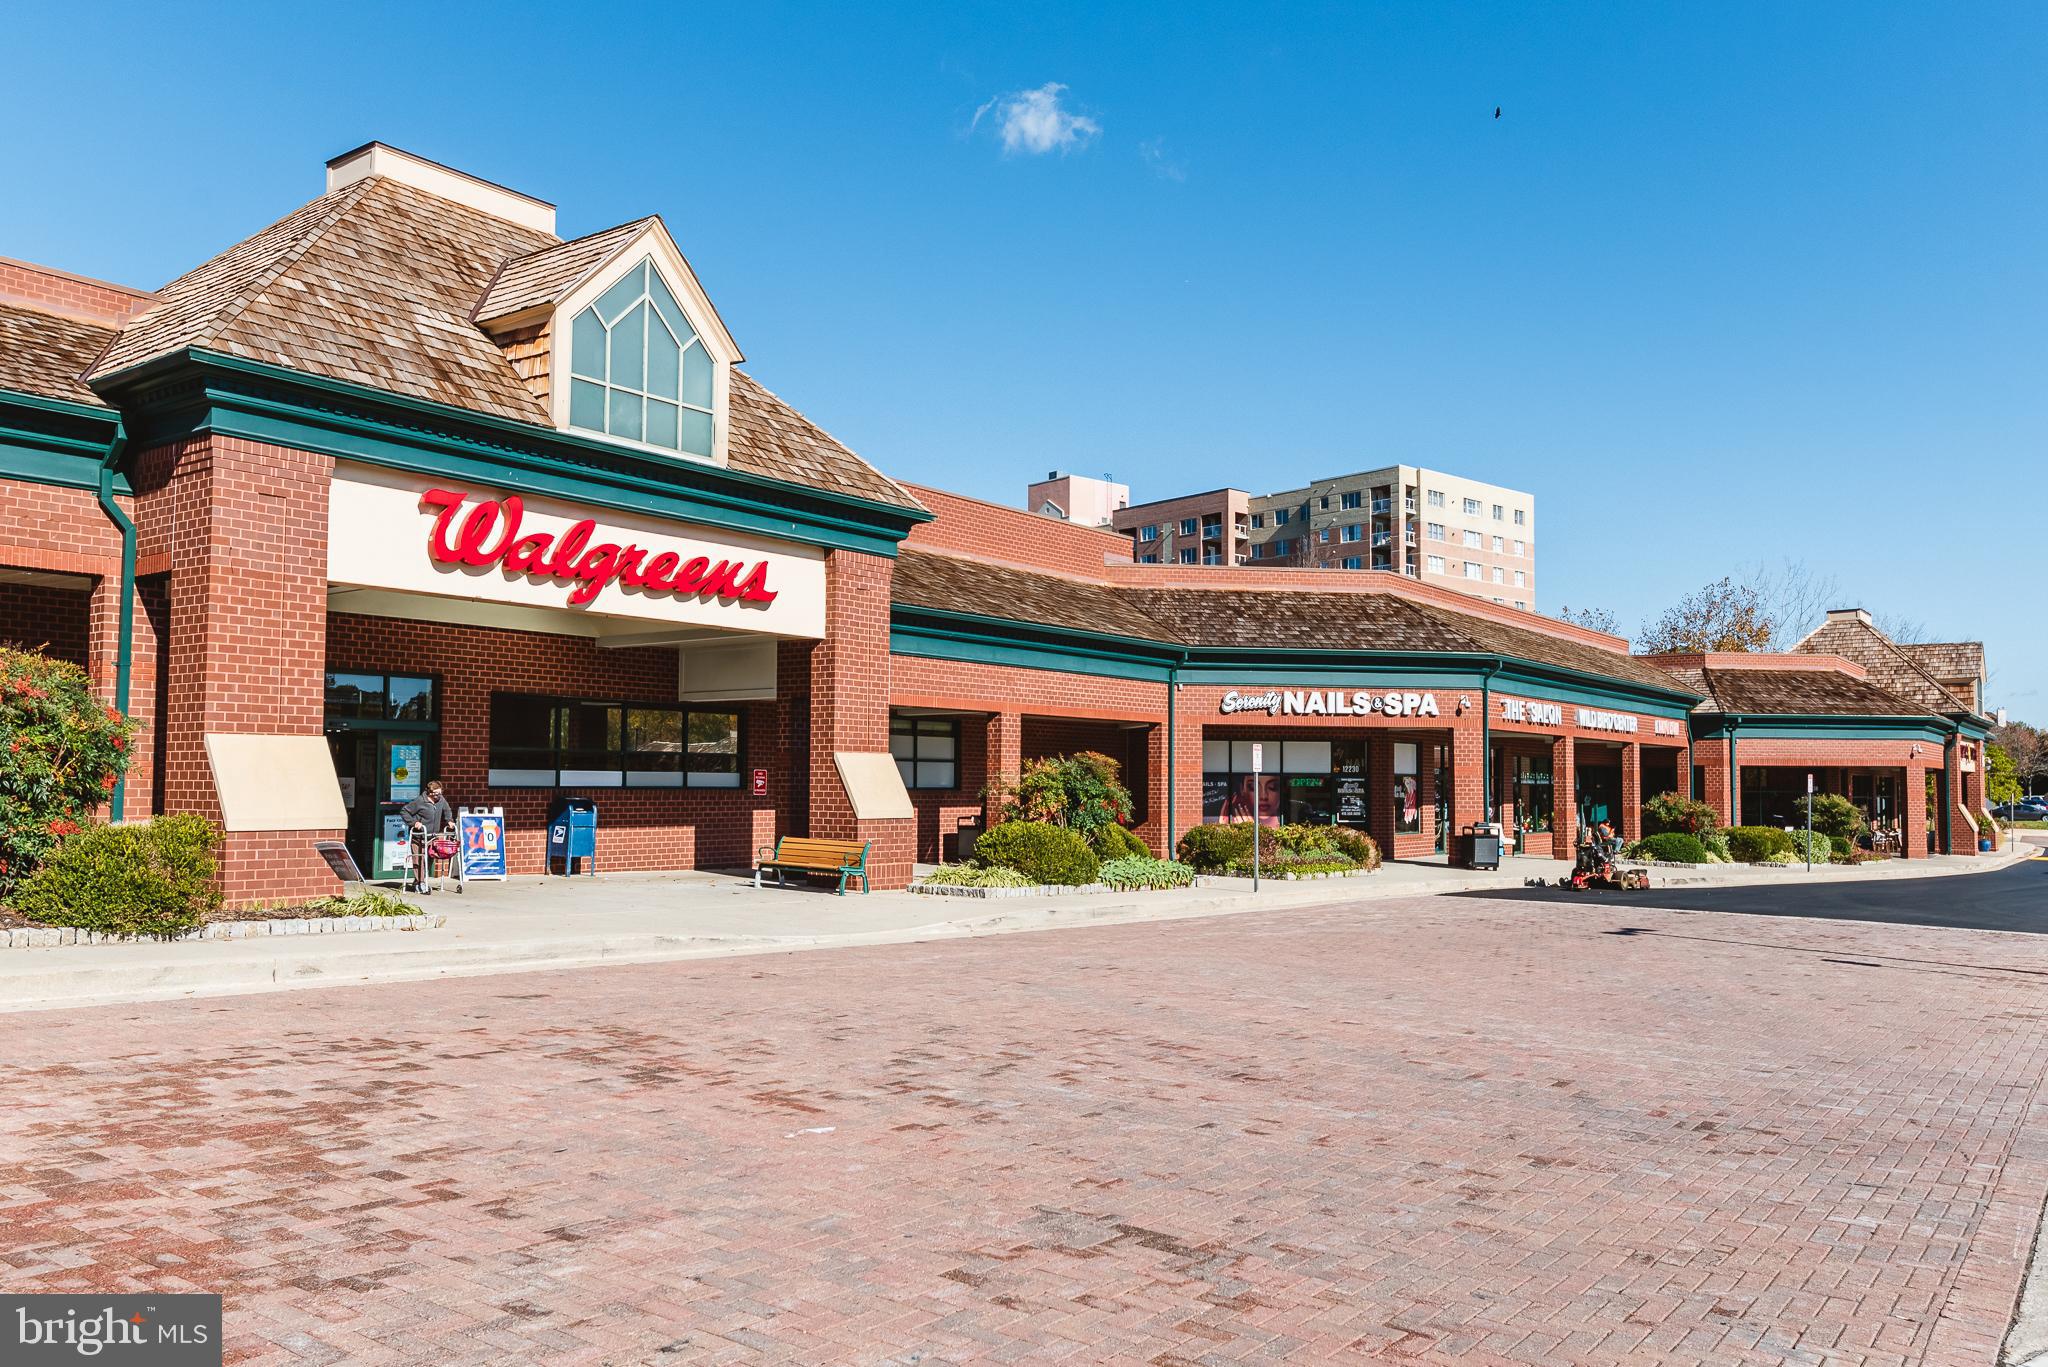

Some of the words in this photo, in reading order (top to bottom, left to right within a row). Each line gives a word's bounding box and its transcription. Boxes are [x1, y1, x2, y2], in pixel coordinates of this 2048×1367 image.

[419, 488, 779, 605] Walgreens
[1221, 690, 1281, 714] Serenity
[1282, 690, 1372, 715] NAILS
[1384, 692, 1440, 716] SPA
[1501, 699, 1527, 720] THE
[1527, 702, 1562, 725] SALON
[1342, 765, 1360, 773] 12230
